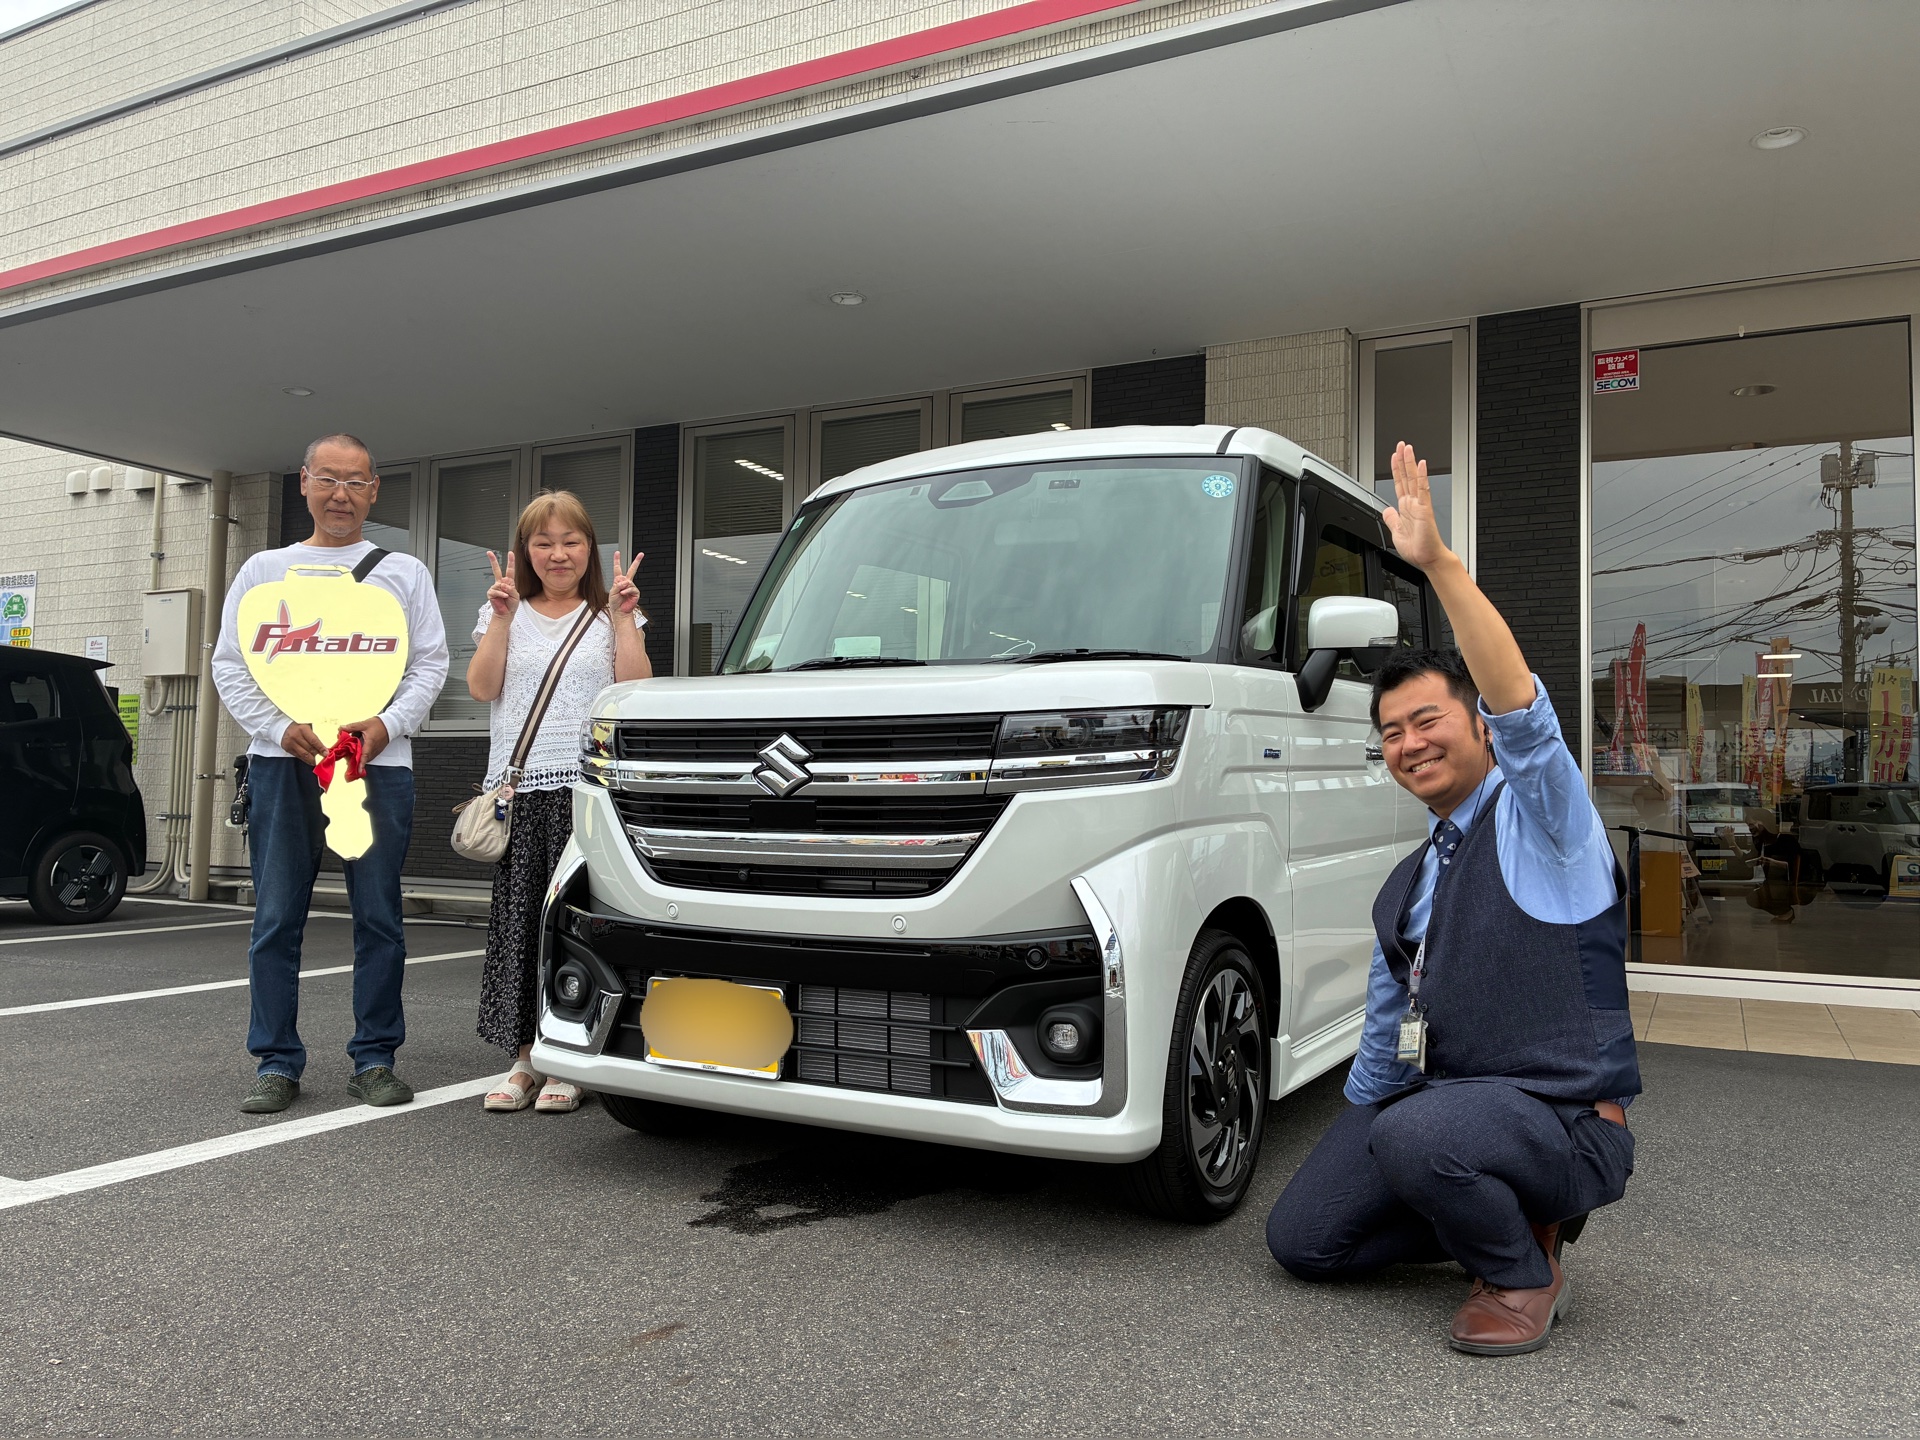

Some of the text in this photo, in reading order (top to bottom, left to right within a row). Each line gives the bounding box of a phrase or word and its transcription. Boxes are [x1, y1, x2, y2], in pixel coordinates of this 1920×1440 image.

[1607, 362, 1625, 370] 設置
[1596, 377, 1636, 390] SECOM
[250, 620, 399, 655] Futaba
